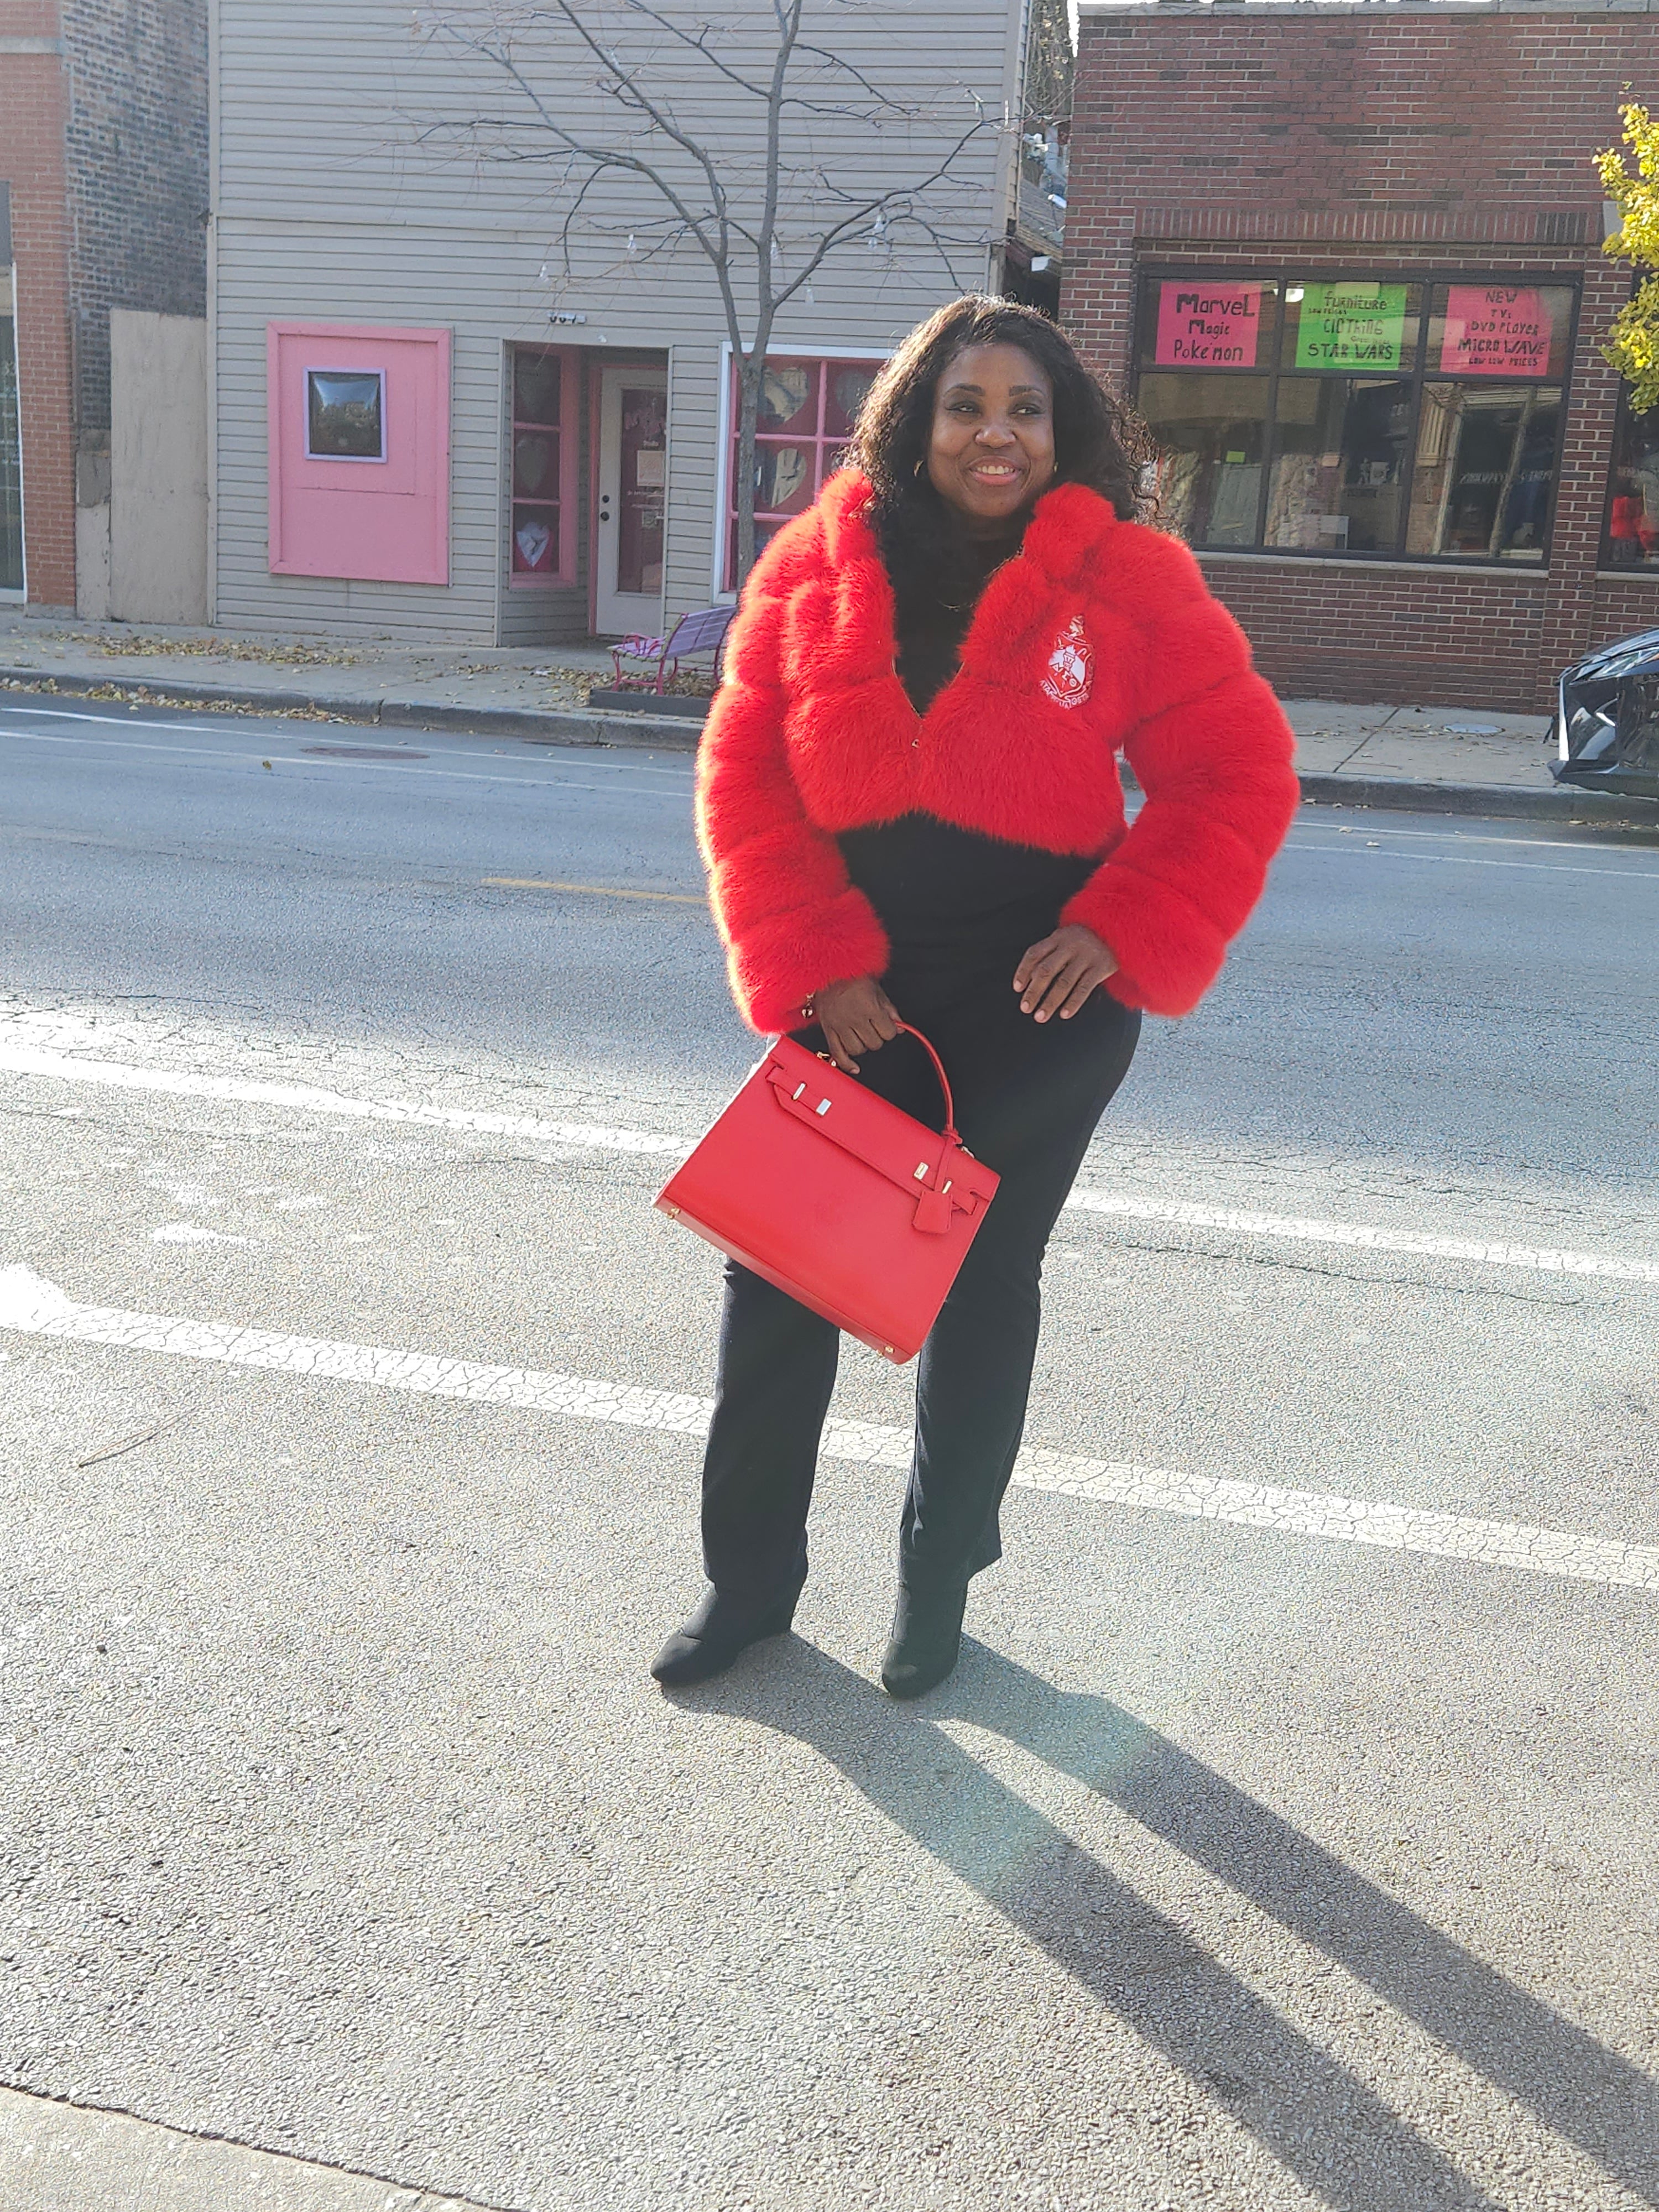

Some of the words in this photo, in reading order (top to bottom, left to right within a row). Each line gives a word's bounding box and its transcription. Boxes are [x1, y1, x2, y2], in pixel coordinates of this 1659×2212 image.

[1486, 291, 1517, 303] NEW
[1189, 319, 1229, 339] Magic
[1472, 321, 1495, 332] DVD
